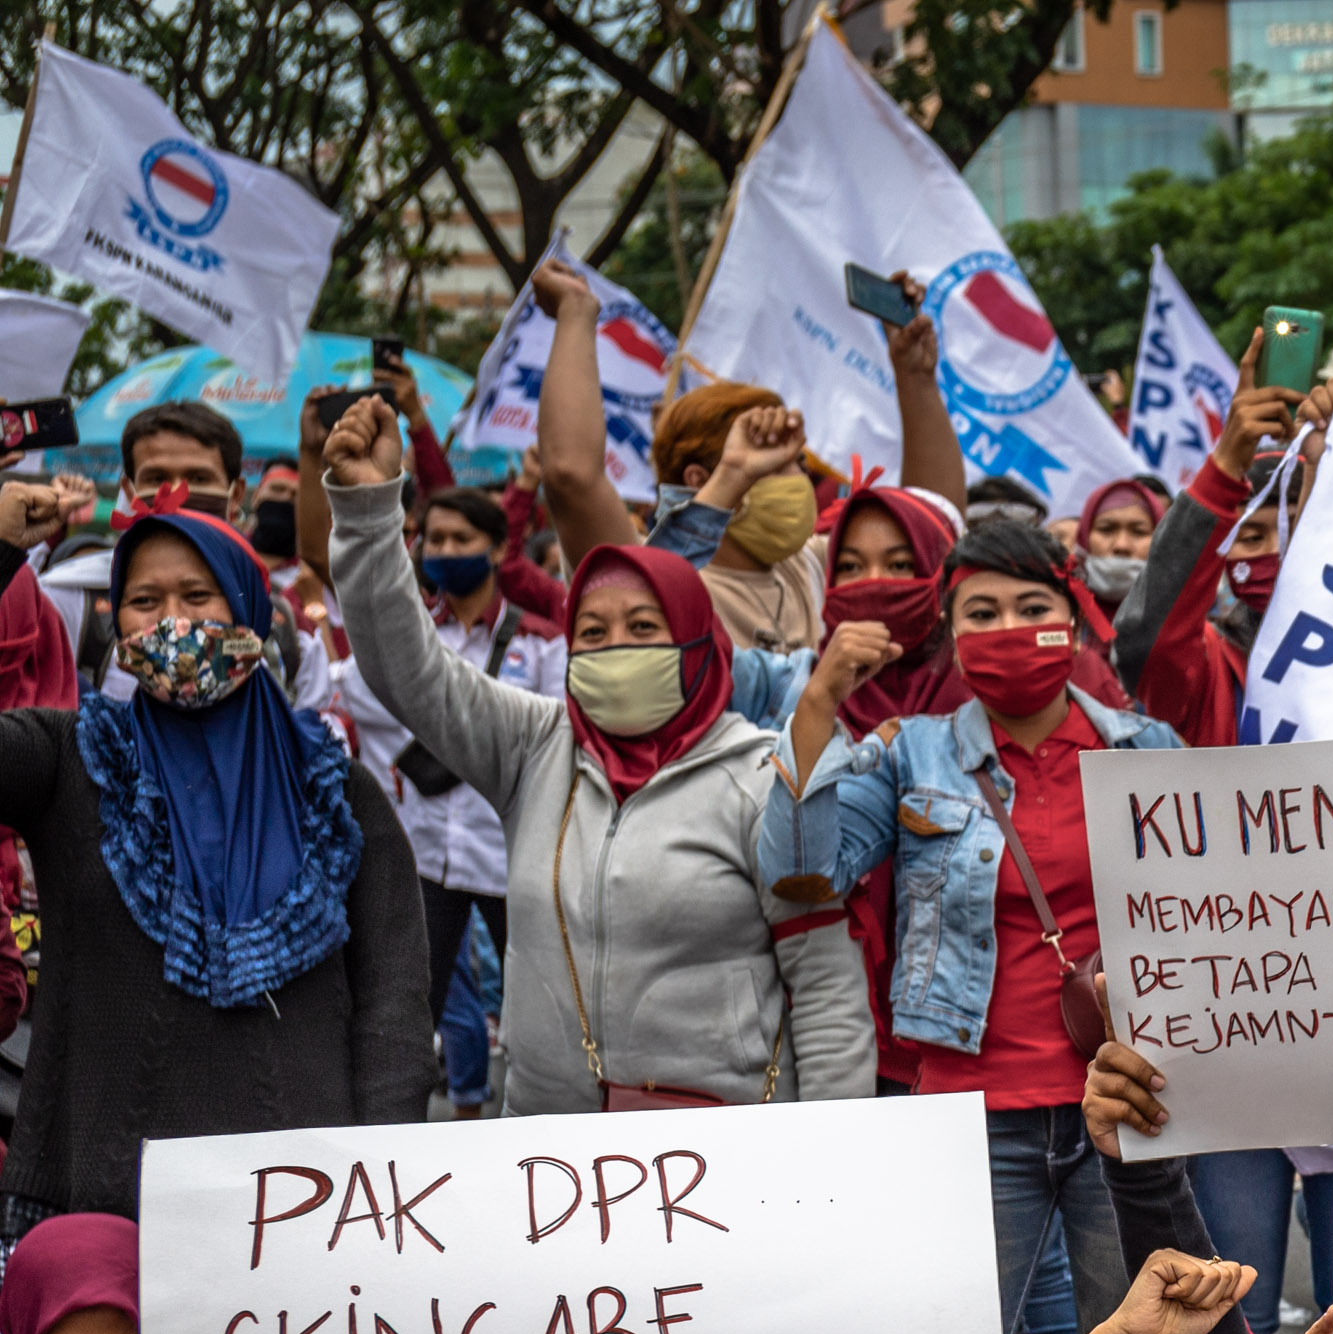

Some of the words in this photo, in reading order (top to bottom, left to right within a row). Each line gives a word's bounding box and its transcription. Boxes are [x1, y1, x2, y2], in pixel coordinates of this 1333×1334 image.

[1129, 792, 1207, 860] KU
[1130, 951, 1317, 999] BETAPA
[248, 1160, 452, 1271] PAK
[517, 1150, 729, 1245] DPR
